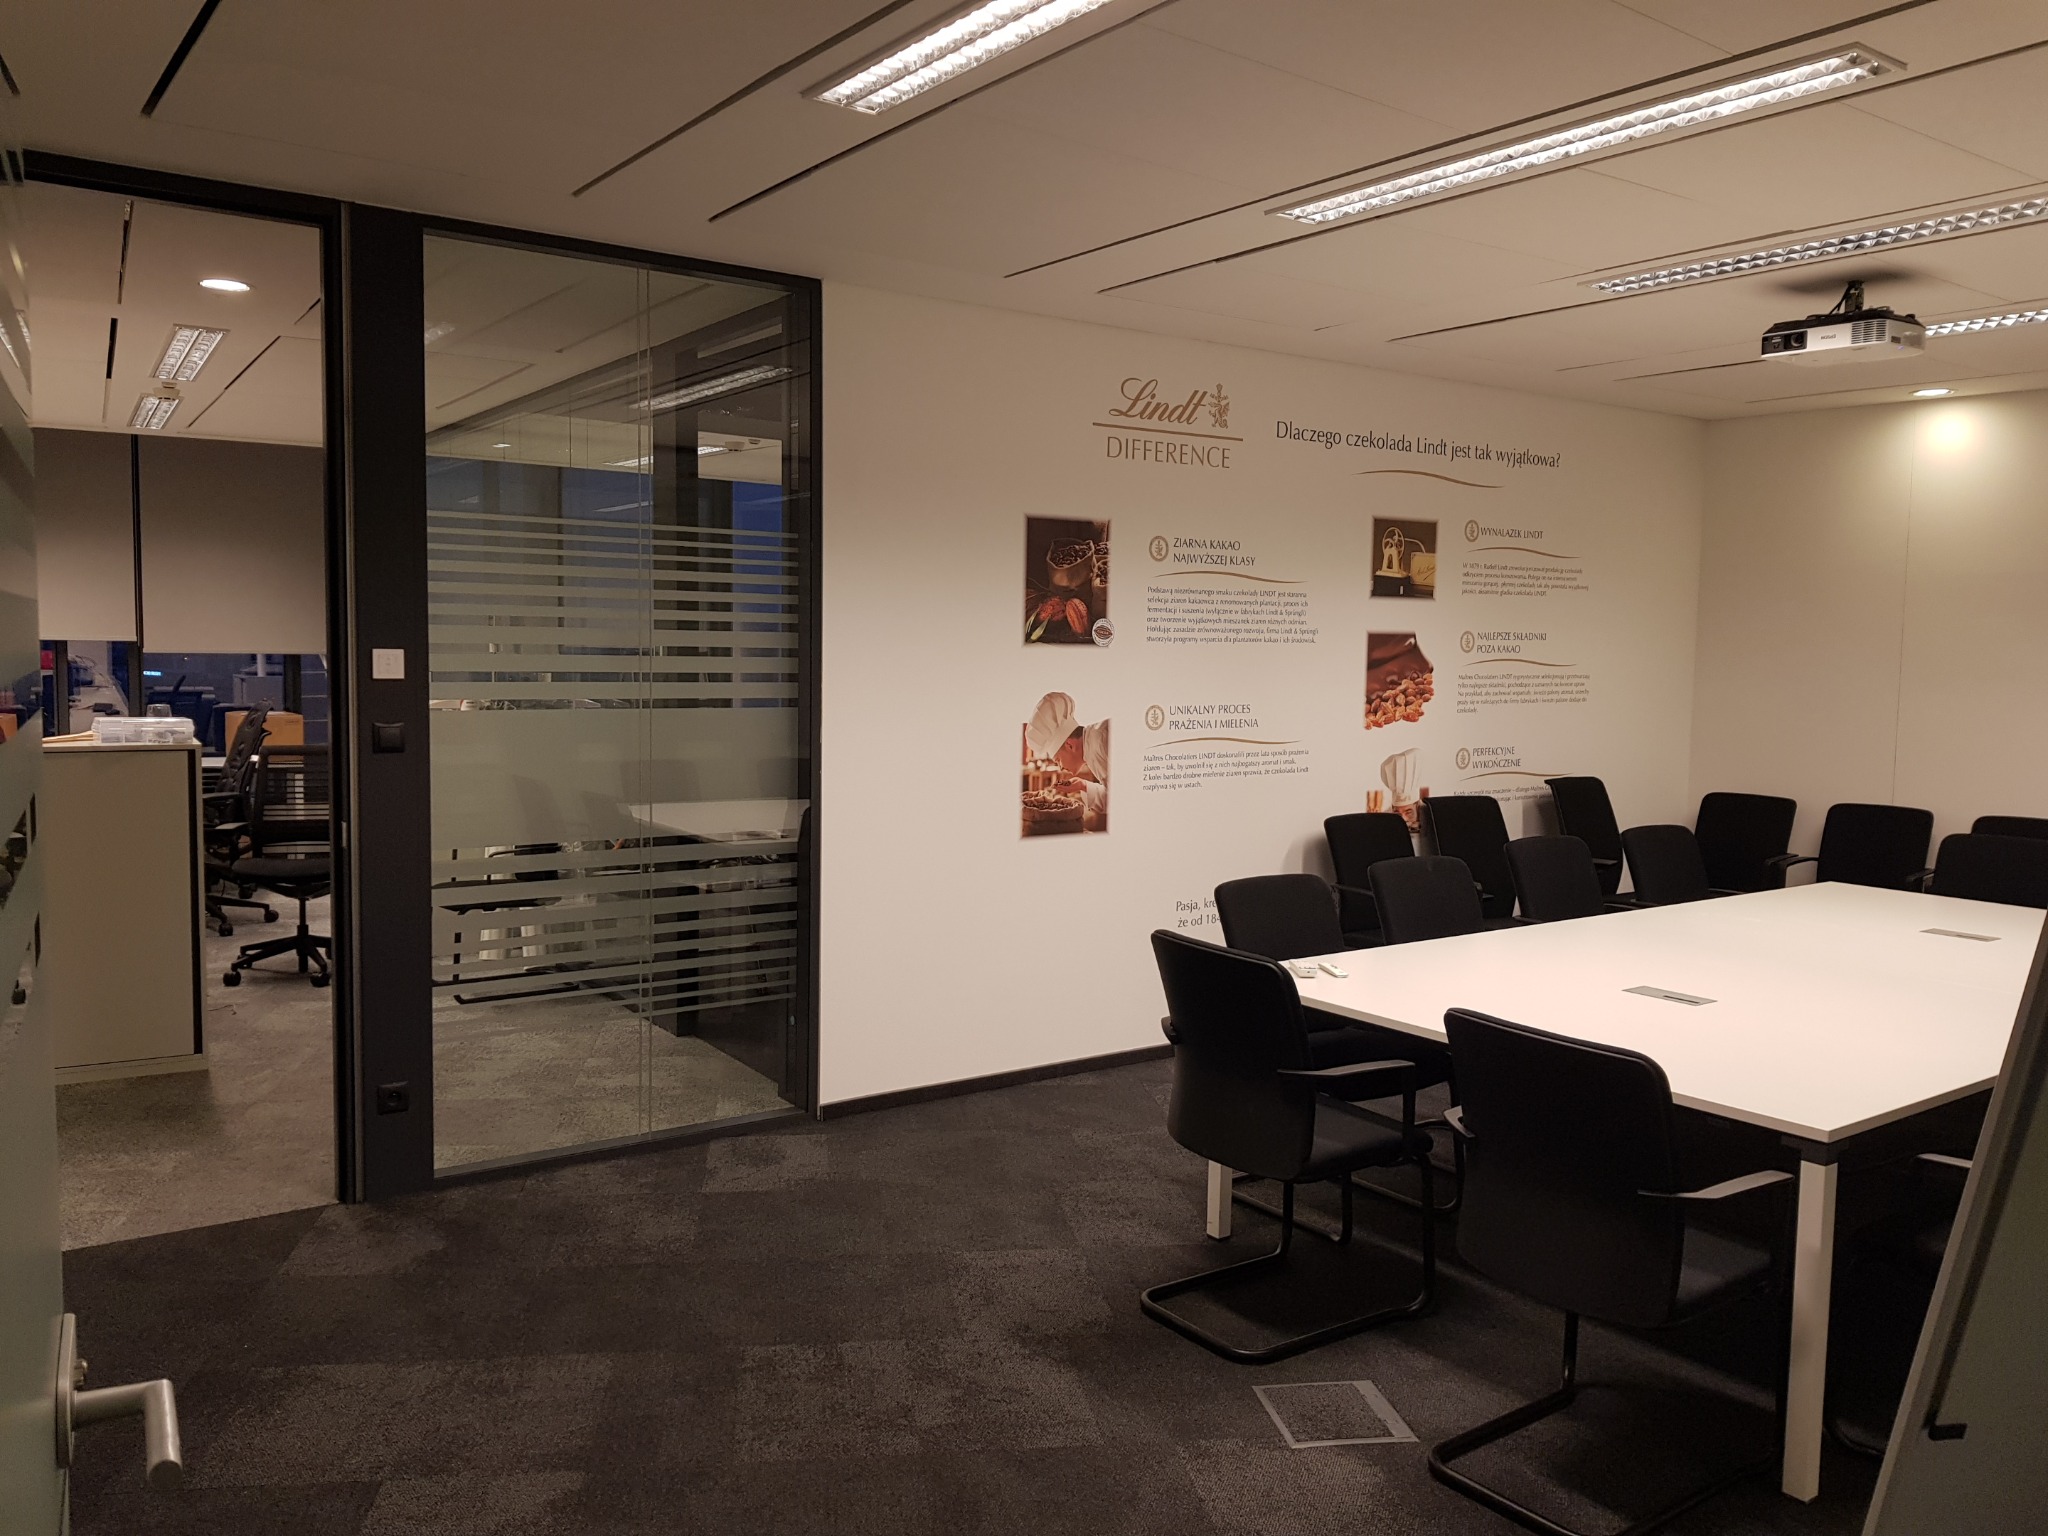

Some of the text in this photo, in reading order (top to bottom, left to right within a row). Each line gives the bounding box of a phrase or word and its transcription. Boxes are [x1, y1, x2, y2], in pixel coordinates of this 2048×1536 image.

[1109, 377, 1208, 425] Lindt
[1276, 420, 1561, 468] Dlaczego czekolada Lindt jest tak wyjątkowa?
[1106, 436, 1231, 469] DIFFERENCE
[1481, 527, 1544, 539] WYNALAZEK LINDT
[1173, 537, 1241, 551] ZIARNA KAKAO
[1173, 552, 1256, 566] NAJWYŻSZEJ KLASY
[1477, 632, 1547, 641] NAJLEPSZE SKŁADNIKI
[1477, 645, 1521, 653] POZA KAKAO
[1169, 704, 1251, 715] UNIKALNY PROCES
[1169, 718, 1259, 730] PRAŻENIA I MIELENIA
[1473, 746, 1516, 756] PERFEKCYJNE
[1472, 757, 1522, 769] WYKOŃCZENIE
[1143, 773, 1148, 781] Z
[1176, 899, 1201, 914] Pasja,
[1178, 917, 1189, 928] że
[1190, 914, 1203, 926] od
